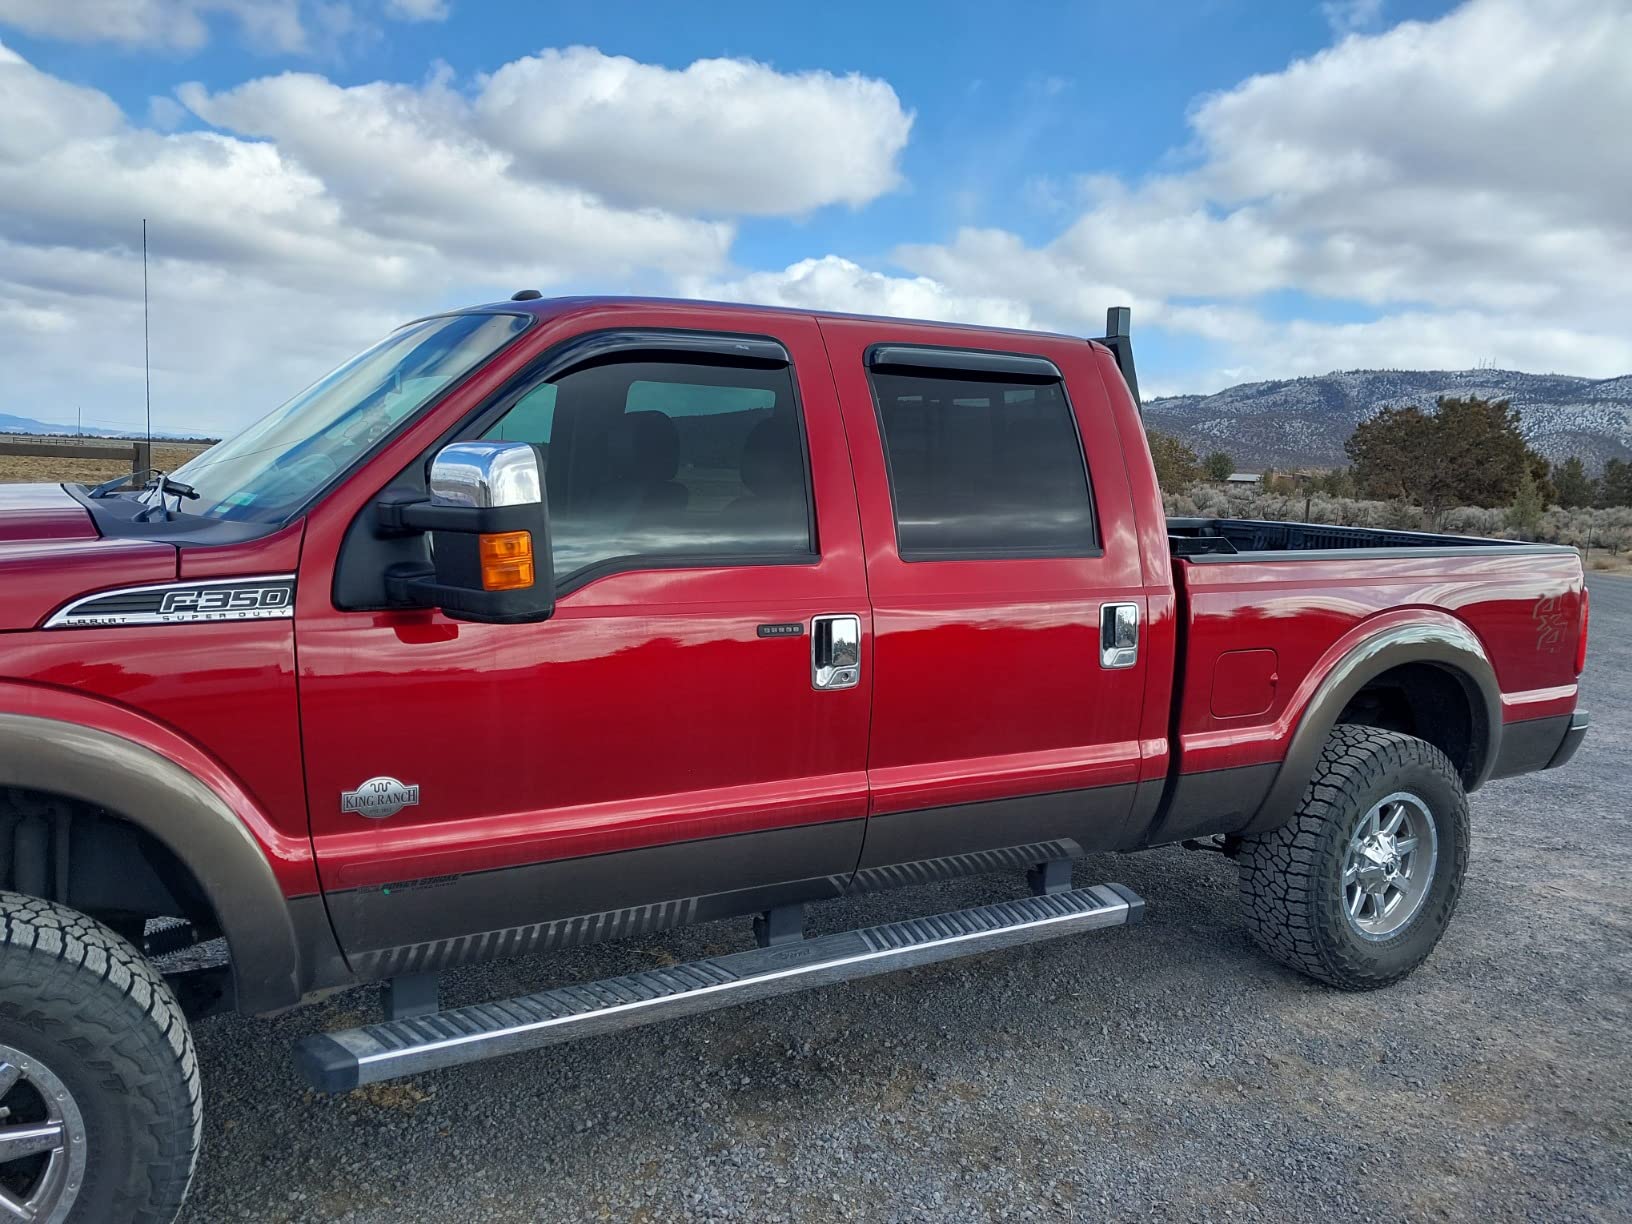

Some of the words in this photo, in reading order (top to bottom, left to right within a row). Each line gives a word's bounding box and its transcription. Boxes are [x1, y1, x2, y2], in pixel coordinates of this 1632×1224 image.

[160, 588, 290, 612] F-350
[162, 613, 226, 621] SUPER
[346, 795, 374, 809] KING
[377, 790, 416, 806] RANCH
